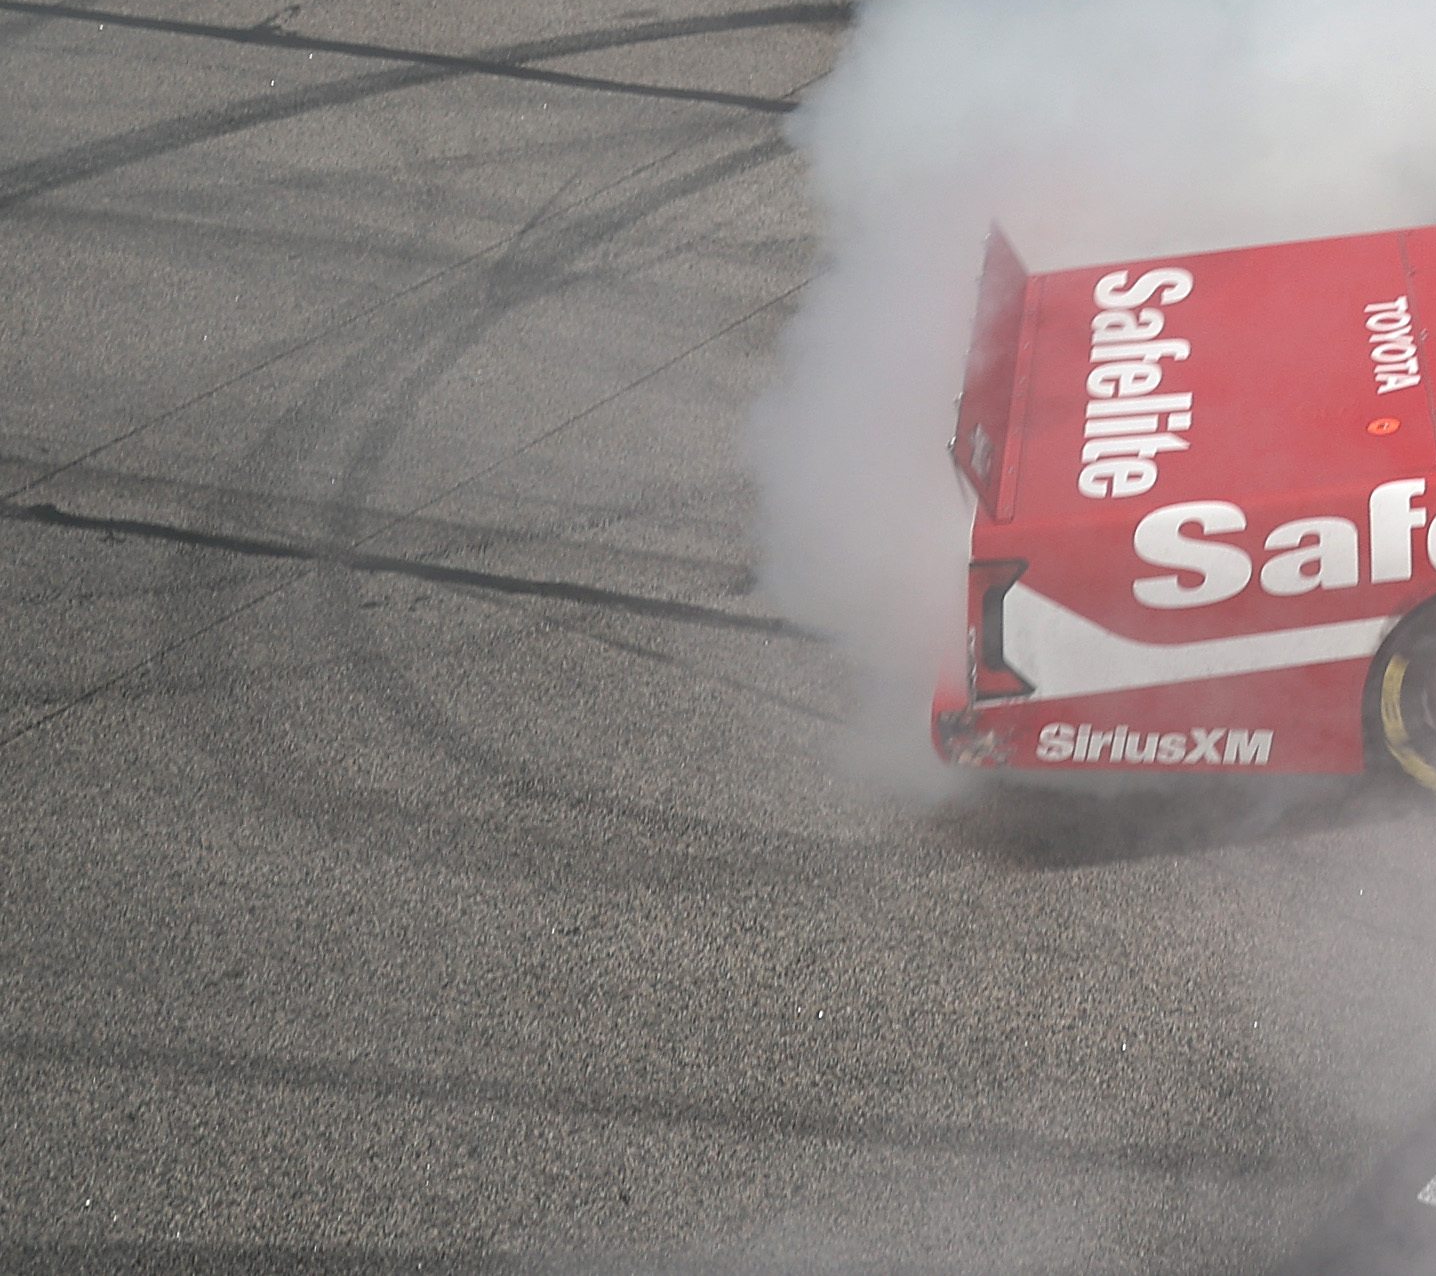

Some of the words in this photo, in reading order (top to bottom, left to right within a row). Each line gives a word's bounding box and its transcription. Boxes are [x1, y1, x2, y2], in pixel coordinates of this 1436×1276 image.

[1077, 267, 1195, 501] Safelite
[1365, 295, 1421, 395] TOYOTA
[1036, 722, 1274, 766] SiriusXM
